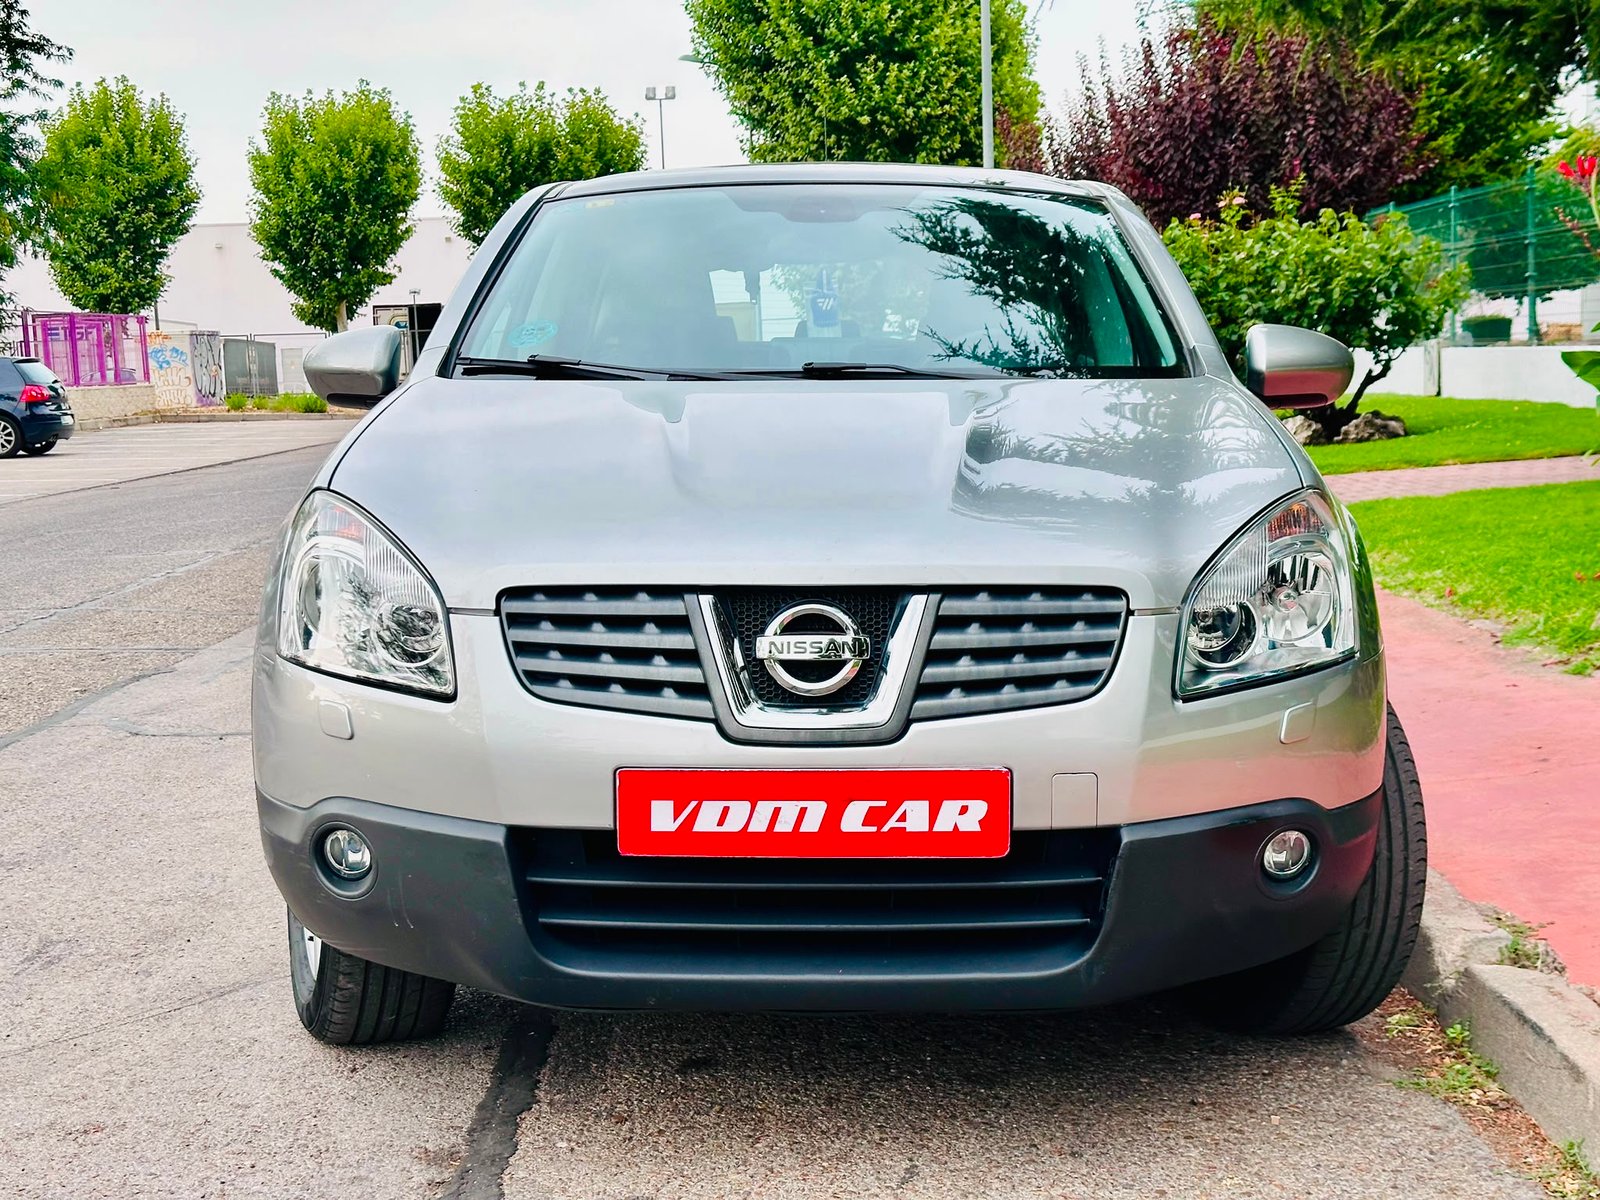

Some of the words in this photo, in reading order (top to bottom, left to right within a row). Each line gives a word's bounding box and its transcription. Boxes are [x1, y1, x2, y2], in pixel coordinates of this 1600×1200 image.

[769, 640, 860, 656] NISSAN
[650, 800, 827, 832] VDM
[841, 800, 988, 832] CAR
